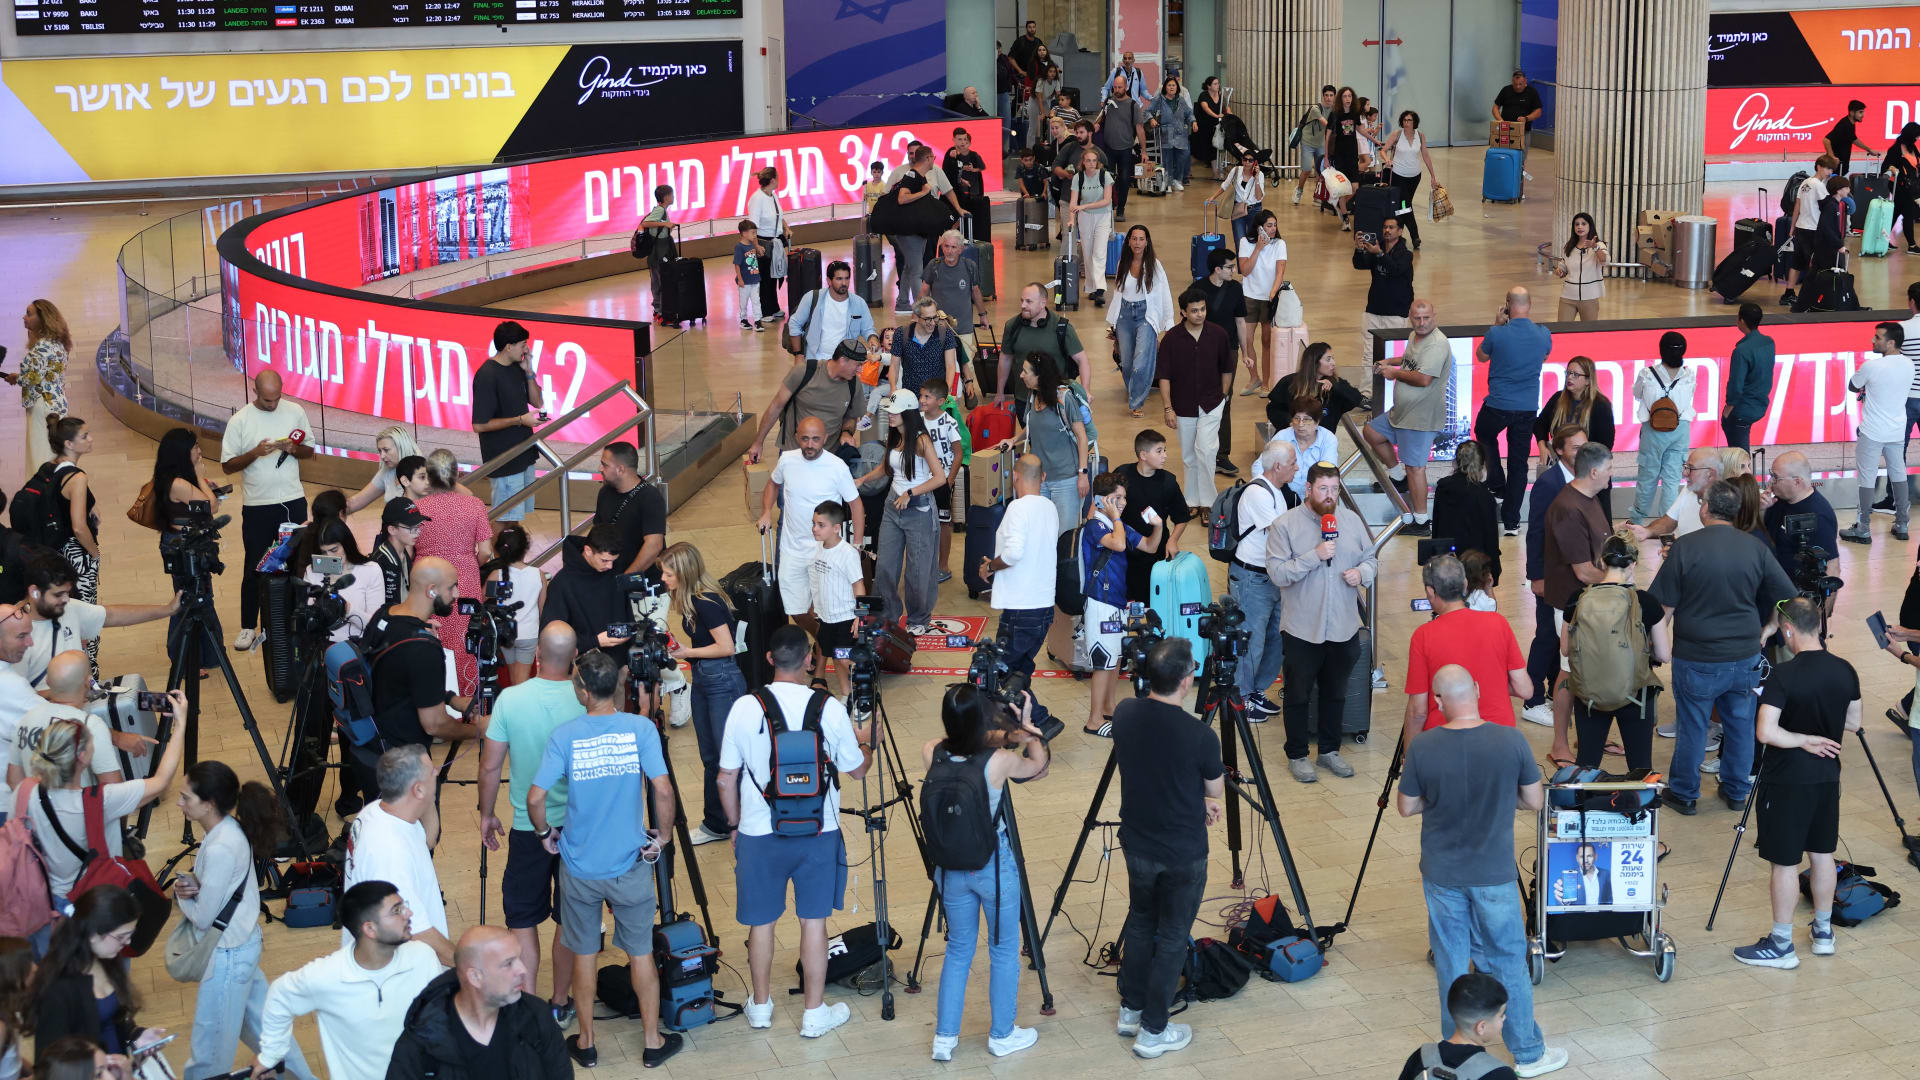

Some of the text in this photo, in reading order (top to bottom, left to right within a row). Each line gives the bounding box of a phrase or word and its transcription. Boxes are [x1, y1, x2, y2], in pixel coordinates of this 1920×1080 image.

[1716, 31, 1768, 43] כאן ולתמיד
[1841, 27, 1911, 51] המחר
[638, 64, 707, 77] כאן ולתמיד
[54, 69, 516, 112] בונים לכם רגעים של אושר
[601, 89, 650, 99] גינדי החזקות
[1756, 133, 1812, 143] גינדי החזקות
[721, 145, 825, 206] מגדלי
[583, 157, 706, 224] מגורים
[255, 301, 344, 385] מגורים
[357, 319, 471, 406] מגדלי
[1326, 520, 1336, 529] 14
[786, 775, 809, 784] LiveU
[1620, 850, 1644, 865] 24
